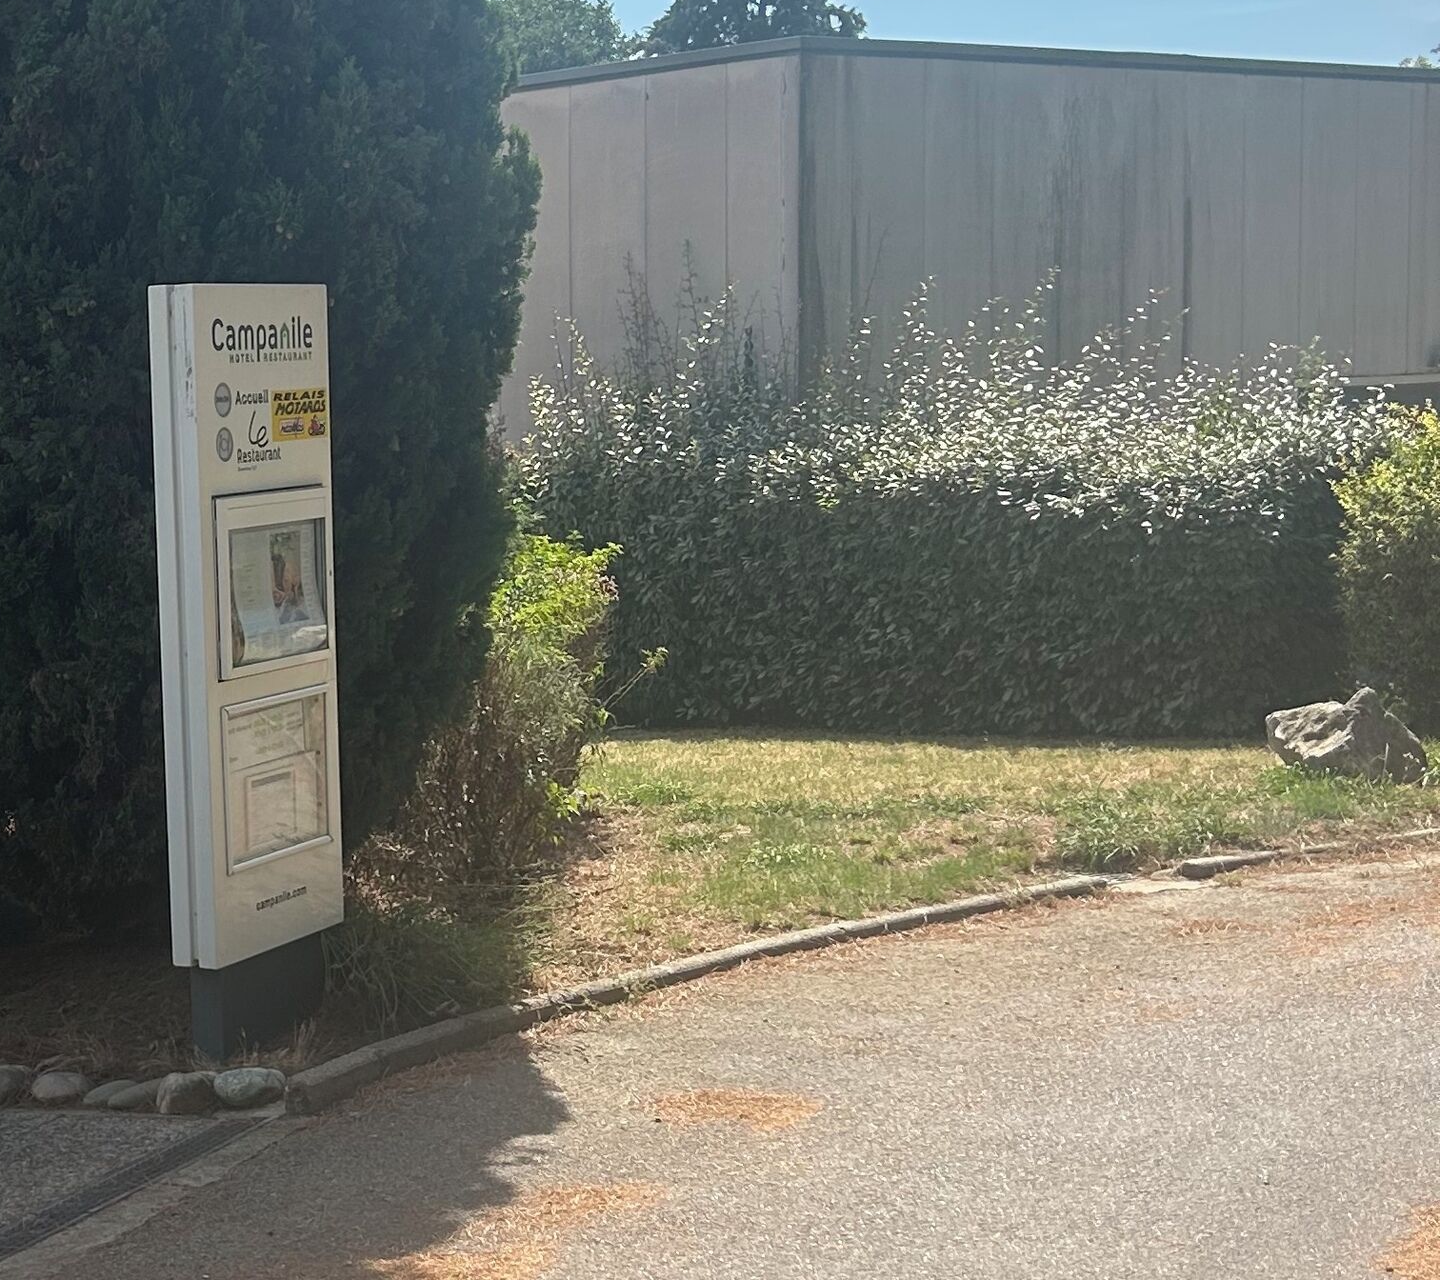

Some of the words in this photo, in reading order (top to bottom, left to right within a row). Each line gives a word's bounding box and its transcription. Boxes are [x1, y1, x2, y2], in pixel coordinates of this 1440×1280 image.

[211, 316, 313, 362] Campanile
[229, 354, 255, 364] HOTEL
[263, 351, 312, 362] RESTAURANT
[235, 388, 269, 405] Accueil
[273, 390, 325, 401] RELAIS
[237, 447, 282, 464] Restaurant
